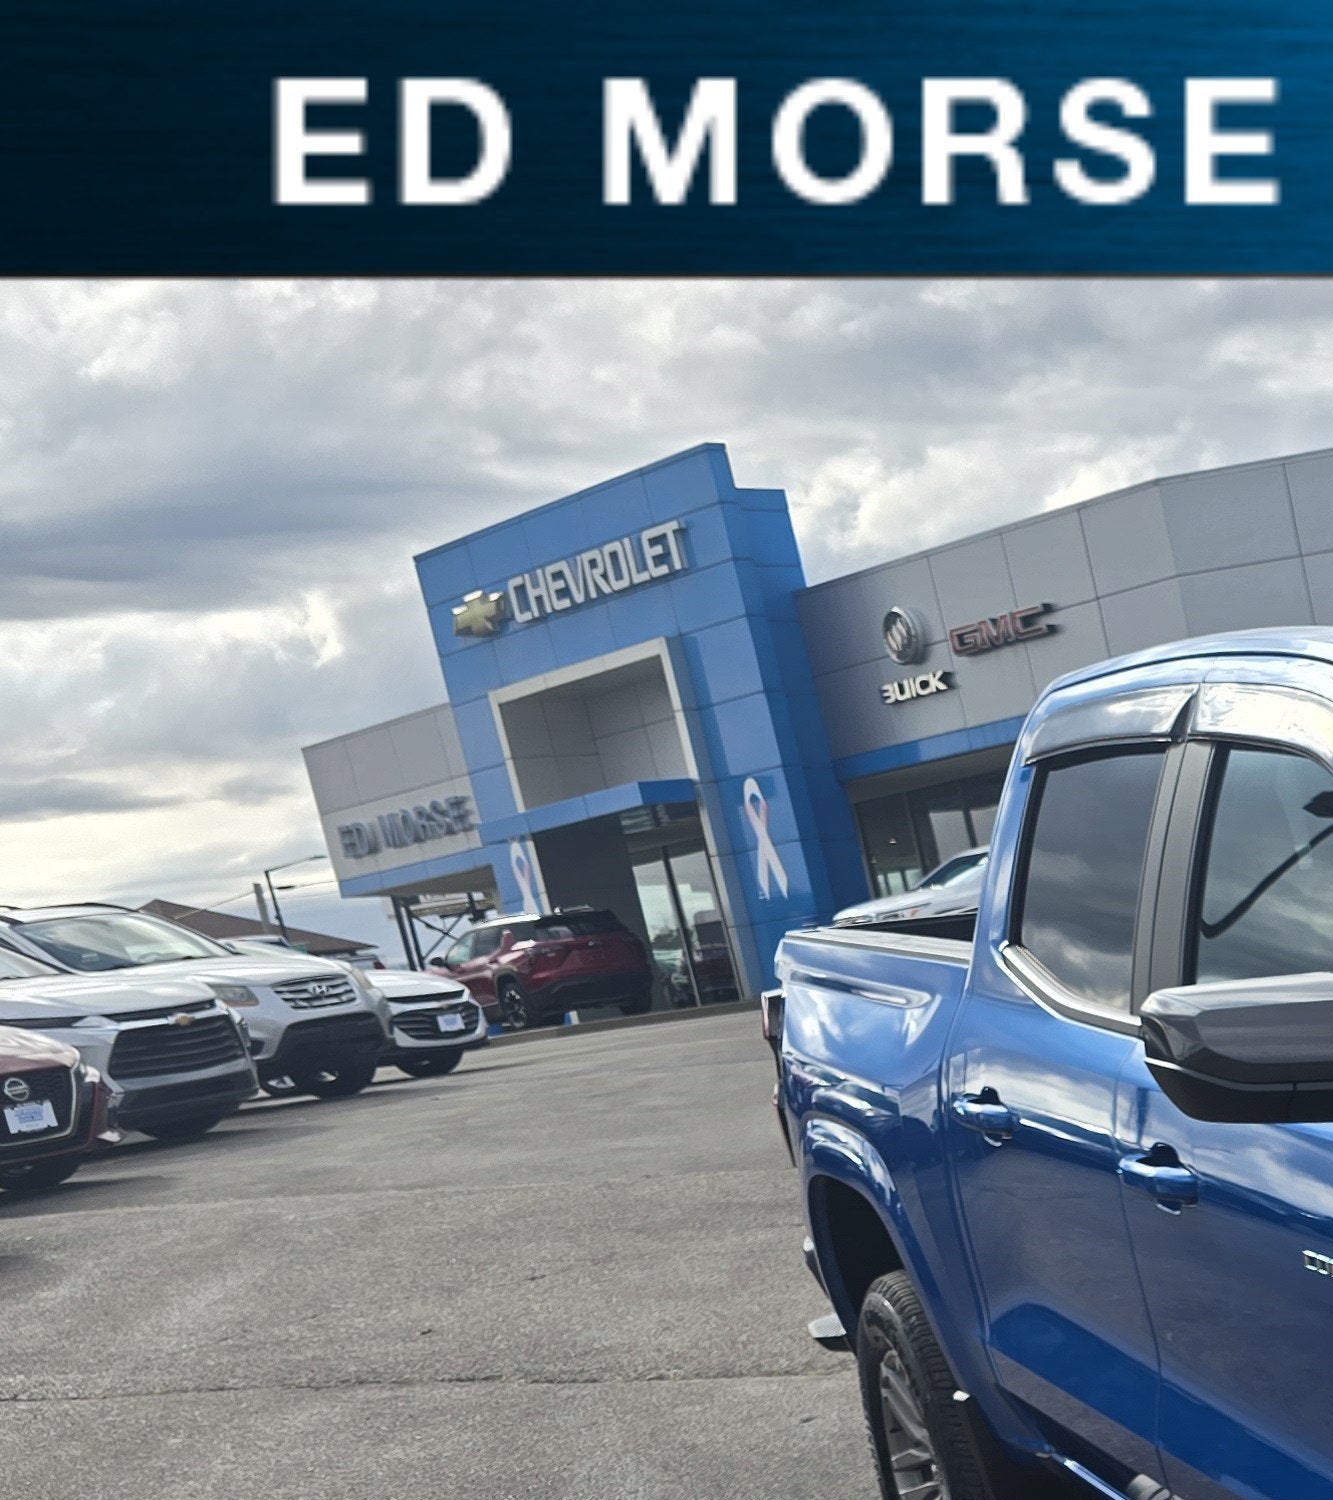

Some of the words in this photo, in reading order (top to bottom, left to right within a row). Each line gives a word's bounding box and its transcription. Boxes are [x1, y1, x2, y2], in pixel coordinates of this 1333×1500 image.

[507, 519, 684, 624] CHEVROLET
[949, 603, 1055, 656] GMC
[879, 669, 950, 704] BUICK
